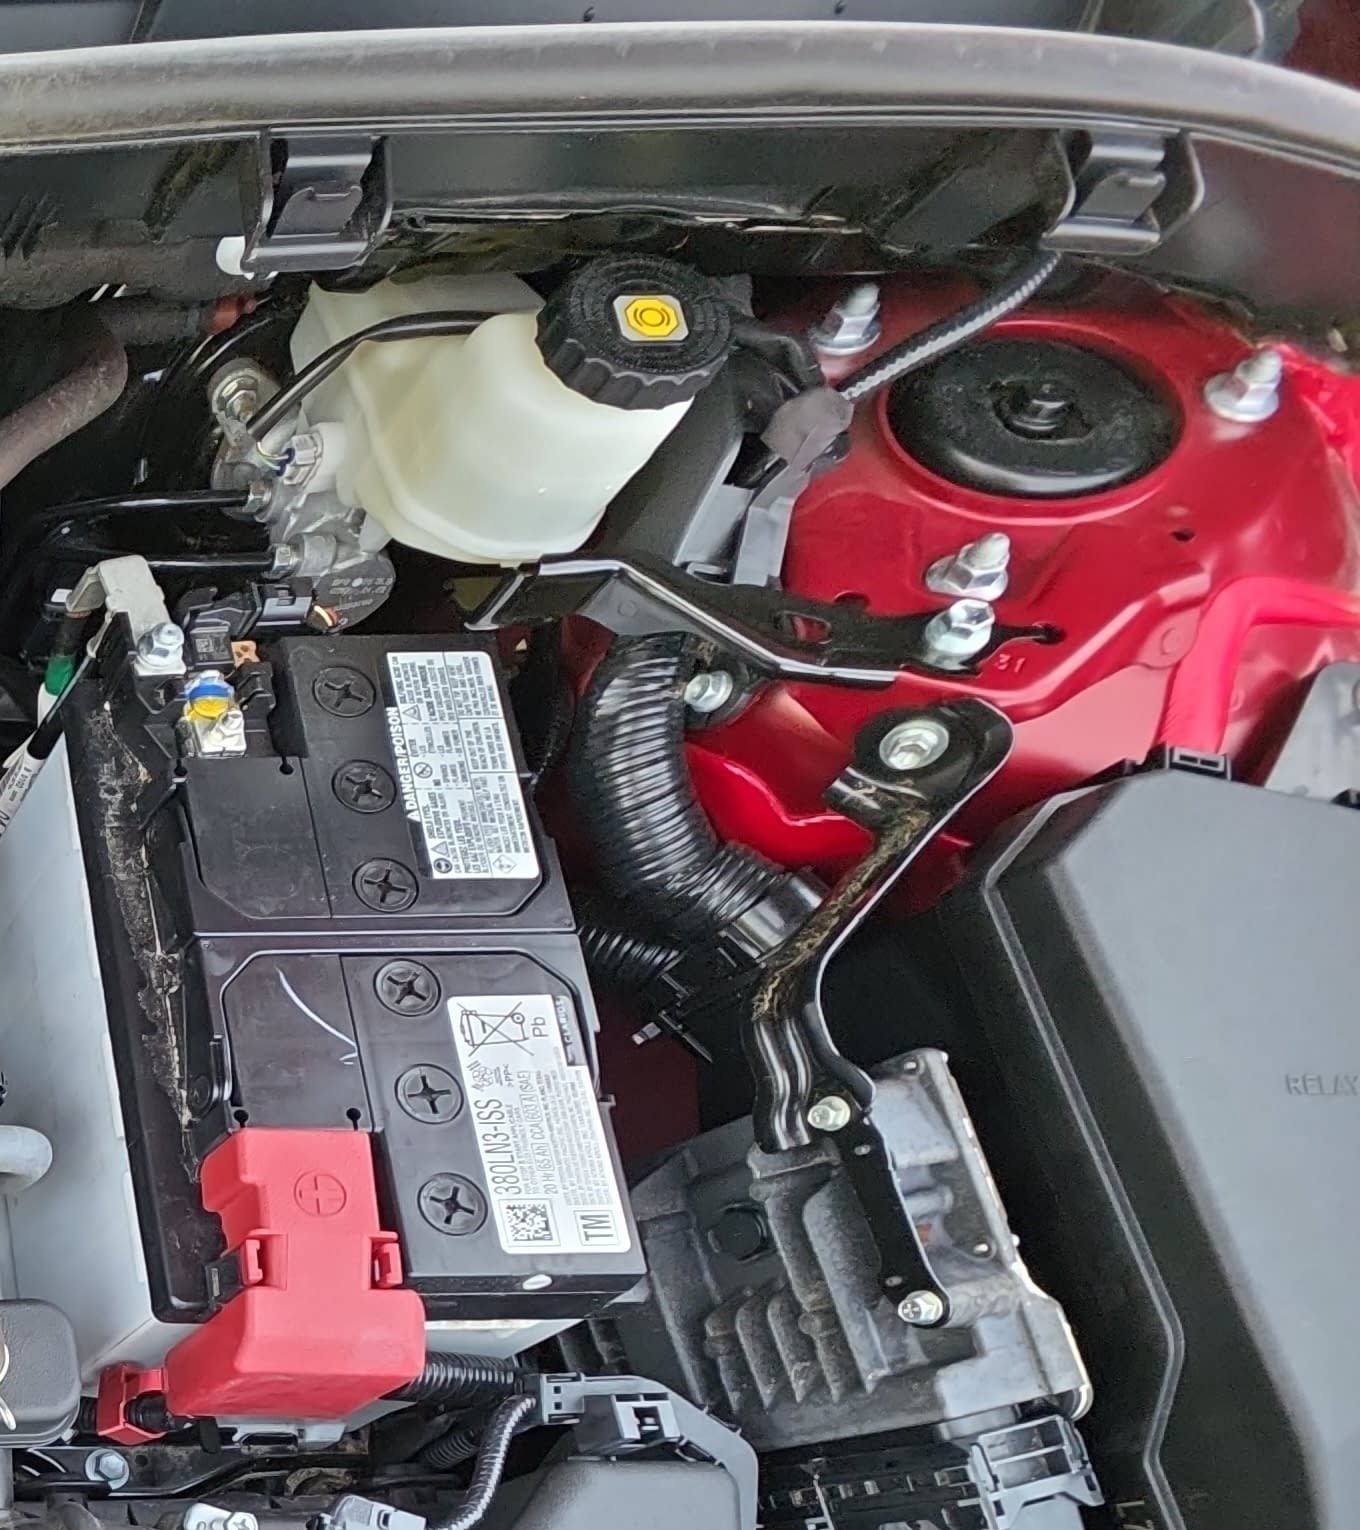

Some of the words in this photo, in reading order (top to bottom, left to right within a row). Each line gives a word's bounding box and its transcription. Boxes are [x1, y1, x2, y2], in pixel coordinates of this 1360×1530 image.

[384, 706, 418, 809] DANGER/POISON
[528, 1016, 549, 1037] Pb
[528, 1122, 545, 1139] CCA
[472, 1098, 522, 1194] 380LN3-ISS
[542, 1183, 558, 1194] 20
[579, 1213, 614, 1240] TM
